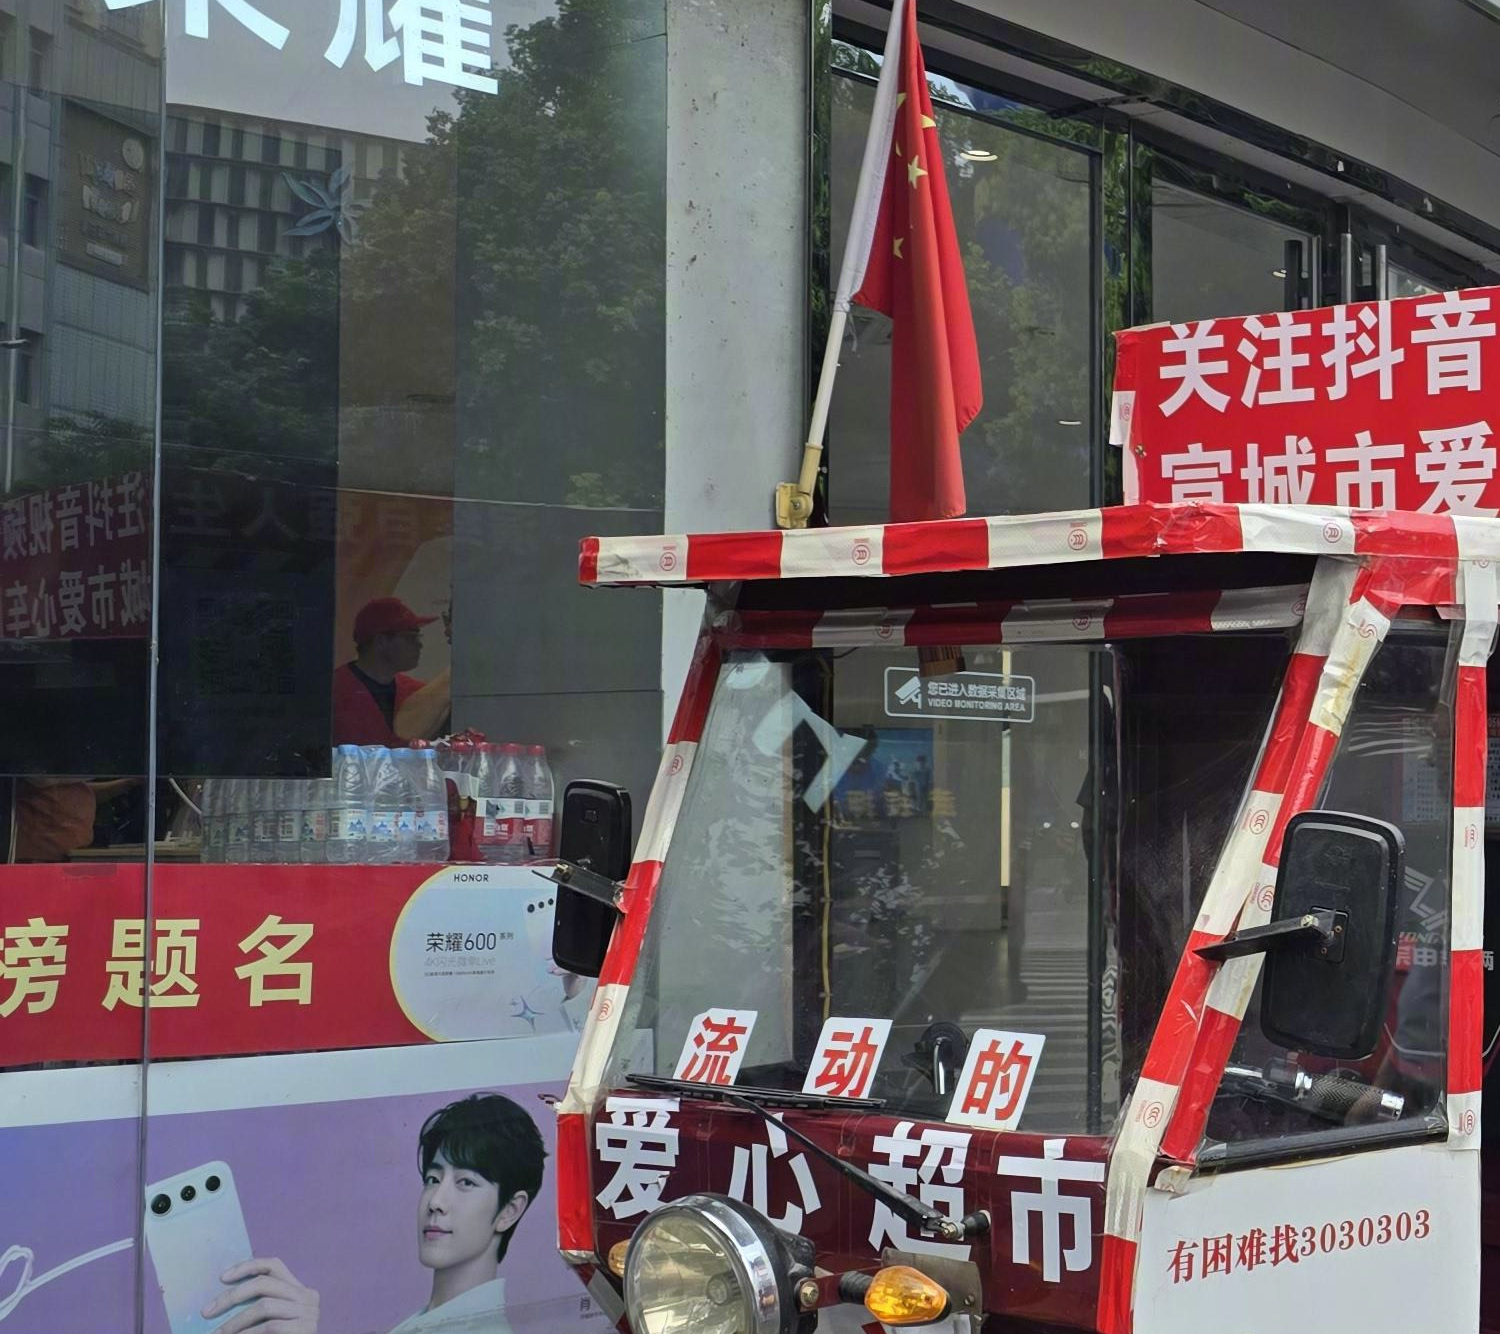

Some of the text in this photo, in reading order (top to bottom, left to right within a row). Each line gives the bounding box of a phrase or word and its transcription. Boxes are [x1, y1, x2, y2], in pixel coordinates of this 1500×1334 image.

[927, 681, 1027, 701] 您已进入数据采集区域
[928, 699, 1026, 712] VIDEO MONITORING AREA
[454, 873, 489, 883] HONOR
[426, 932, 497, 953] 荣耀600
[596, 1097, 1106, 1284] 爱心超市
[1166, 1209, 1431, 1284] 有困难找3030303
